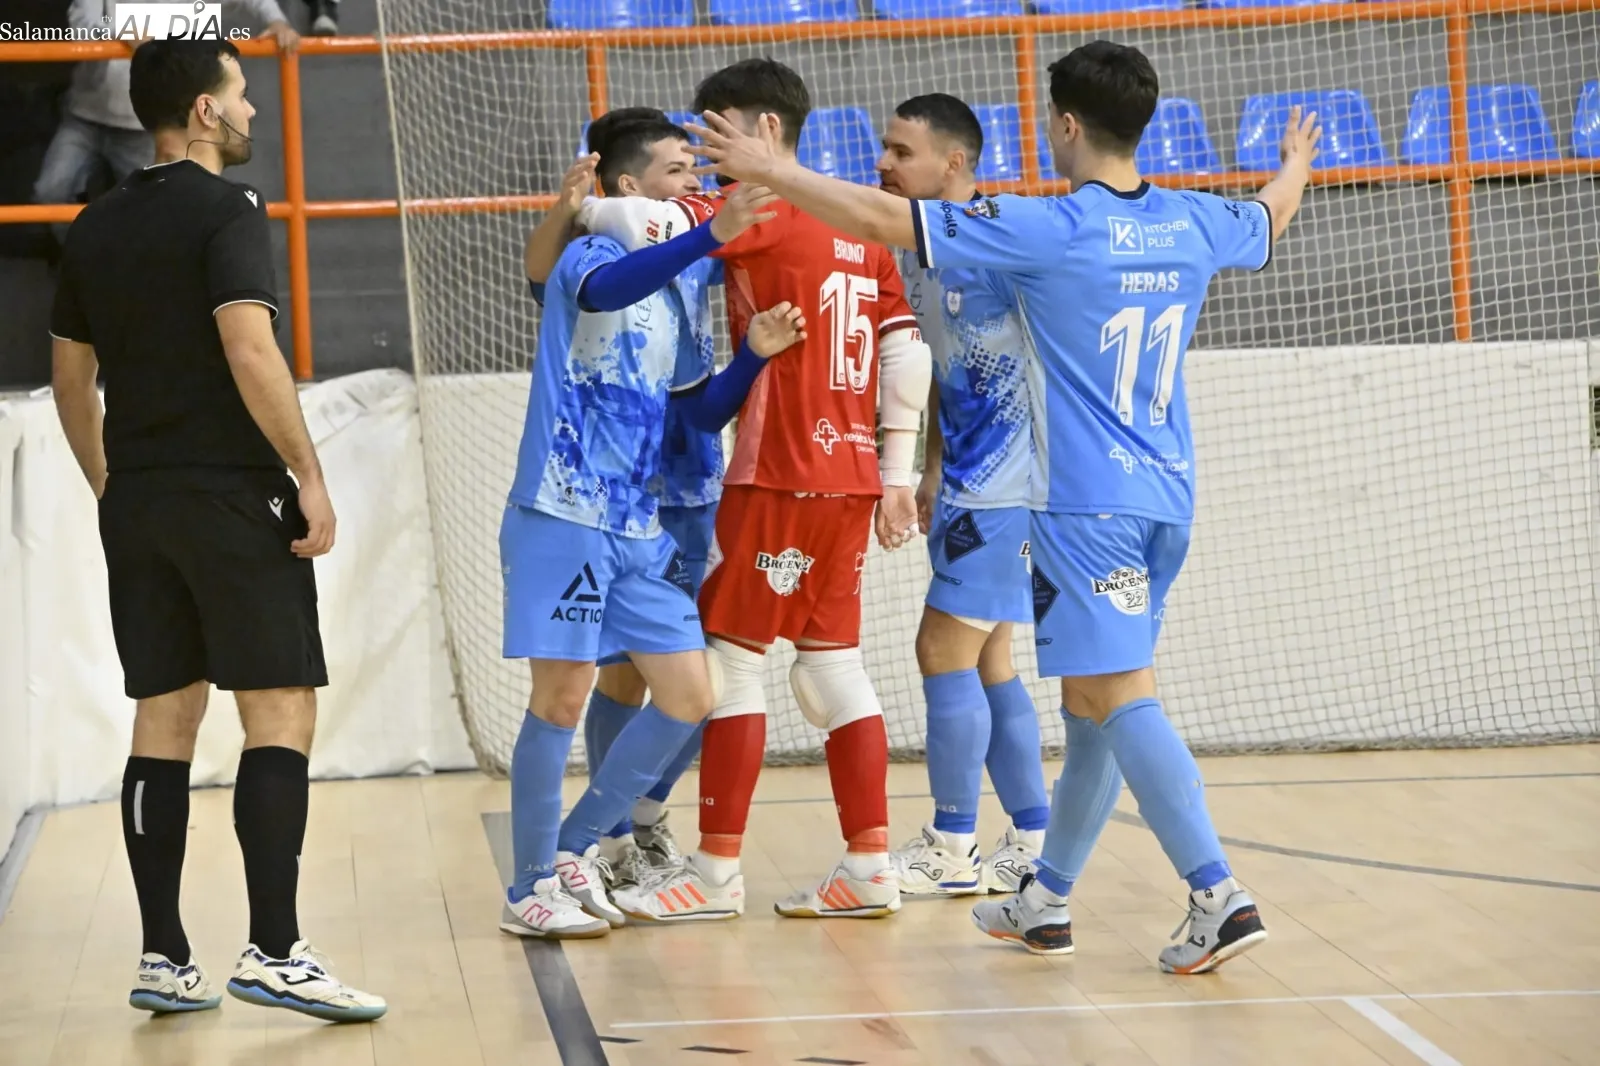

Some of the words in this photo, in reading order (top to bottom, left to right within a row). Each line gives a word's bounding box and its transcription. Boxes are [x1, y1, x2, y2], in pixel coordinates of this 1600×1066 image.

[833, 238, 865, 264] BRUNO
[1148, 236, 1175, 248] PLUS
[1120, 271, 1180, 294] HERAS
[819, 271, 878, 394] 15
[1100, 304, 1186, 427] 11
